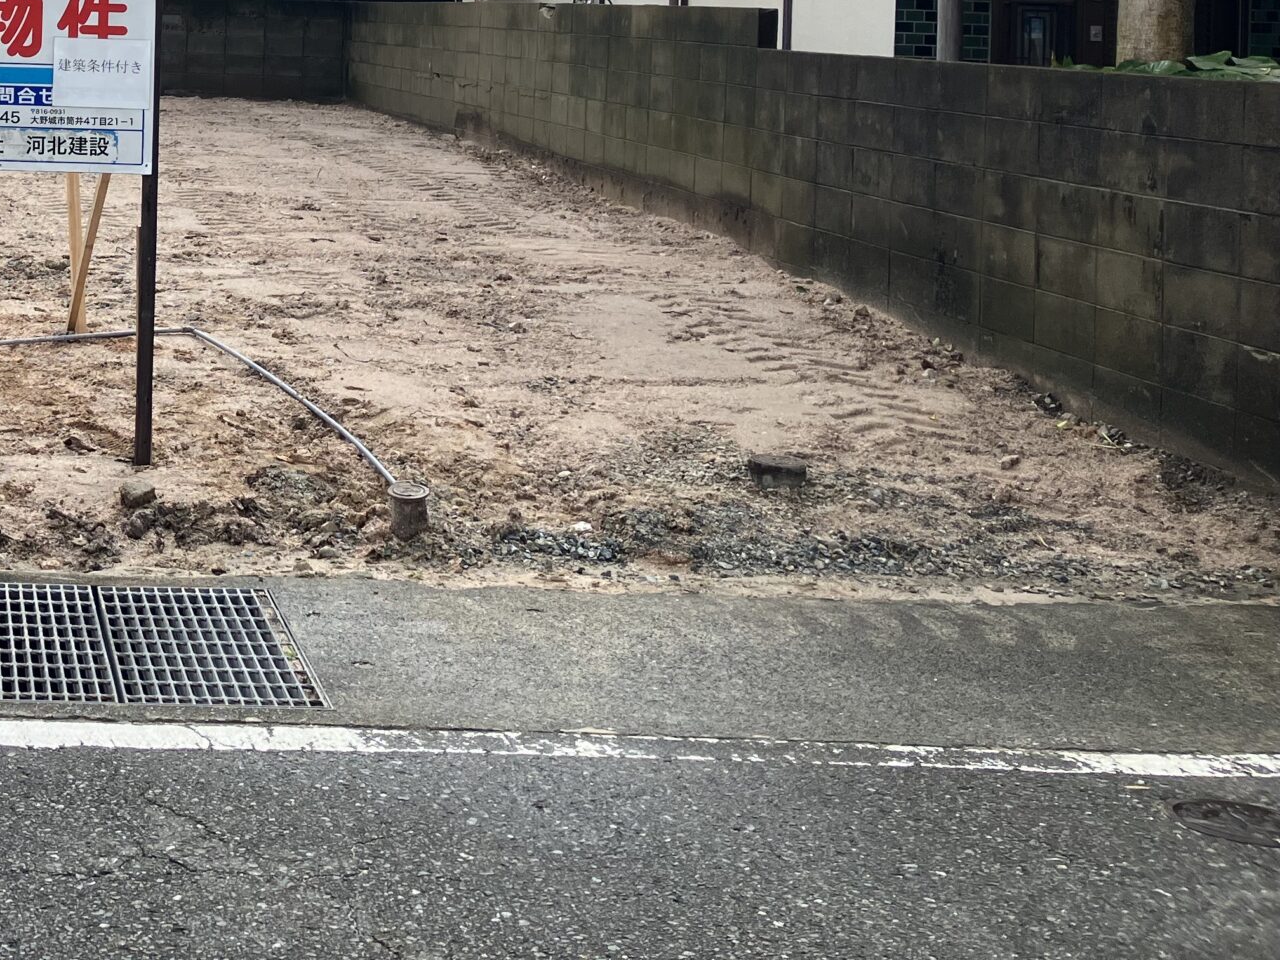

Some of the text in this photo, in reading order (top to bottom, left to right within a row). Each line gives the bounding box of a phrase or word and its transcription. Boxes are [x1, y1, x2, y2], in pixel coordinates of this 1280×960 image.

[57, 57, 143, 75] 建築条件付き
[26, 135, 110, 157] 河北建設
